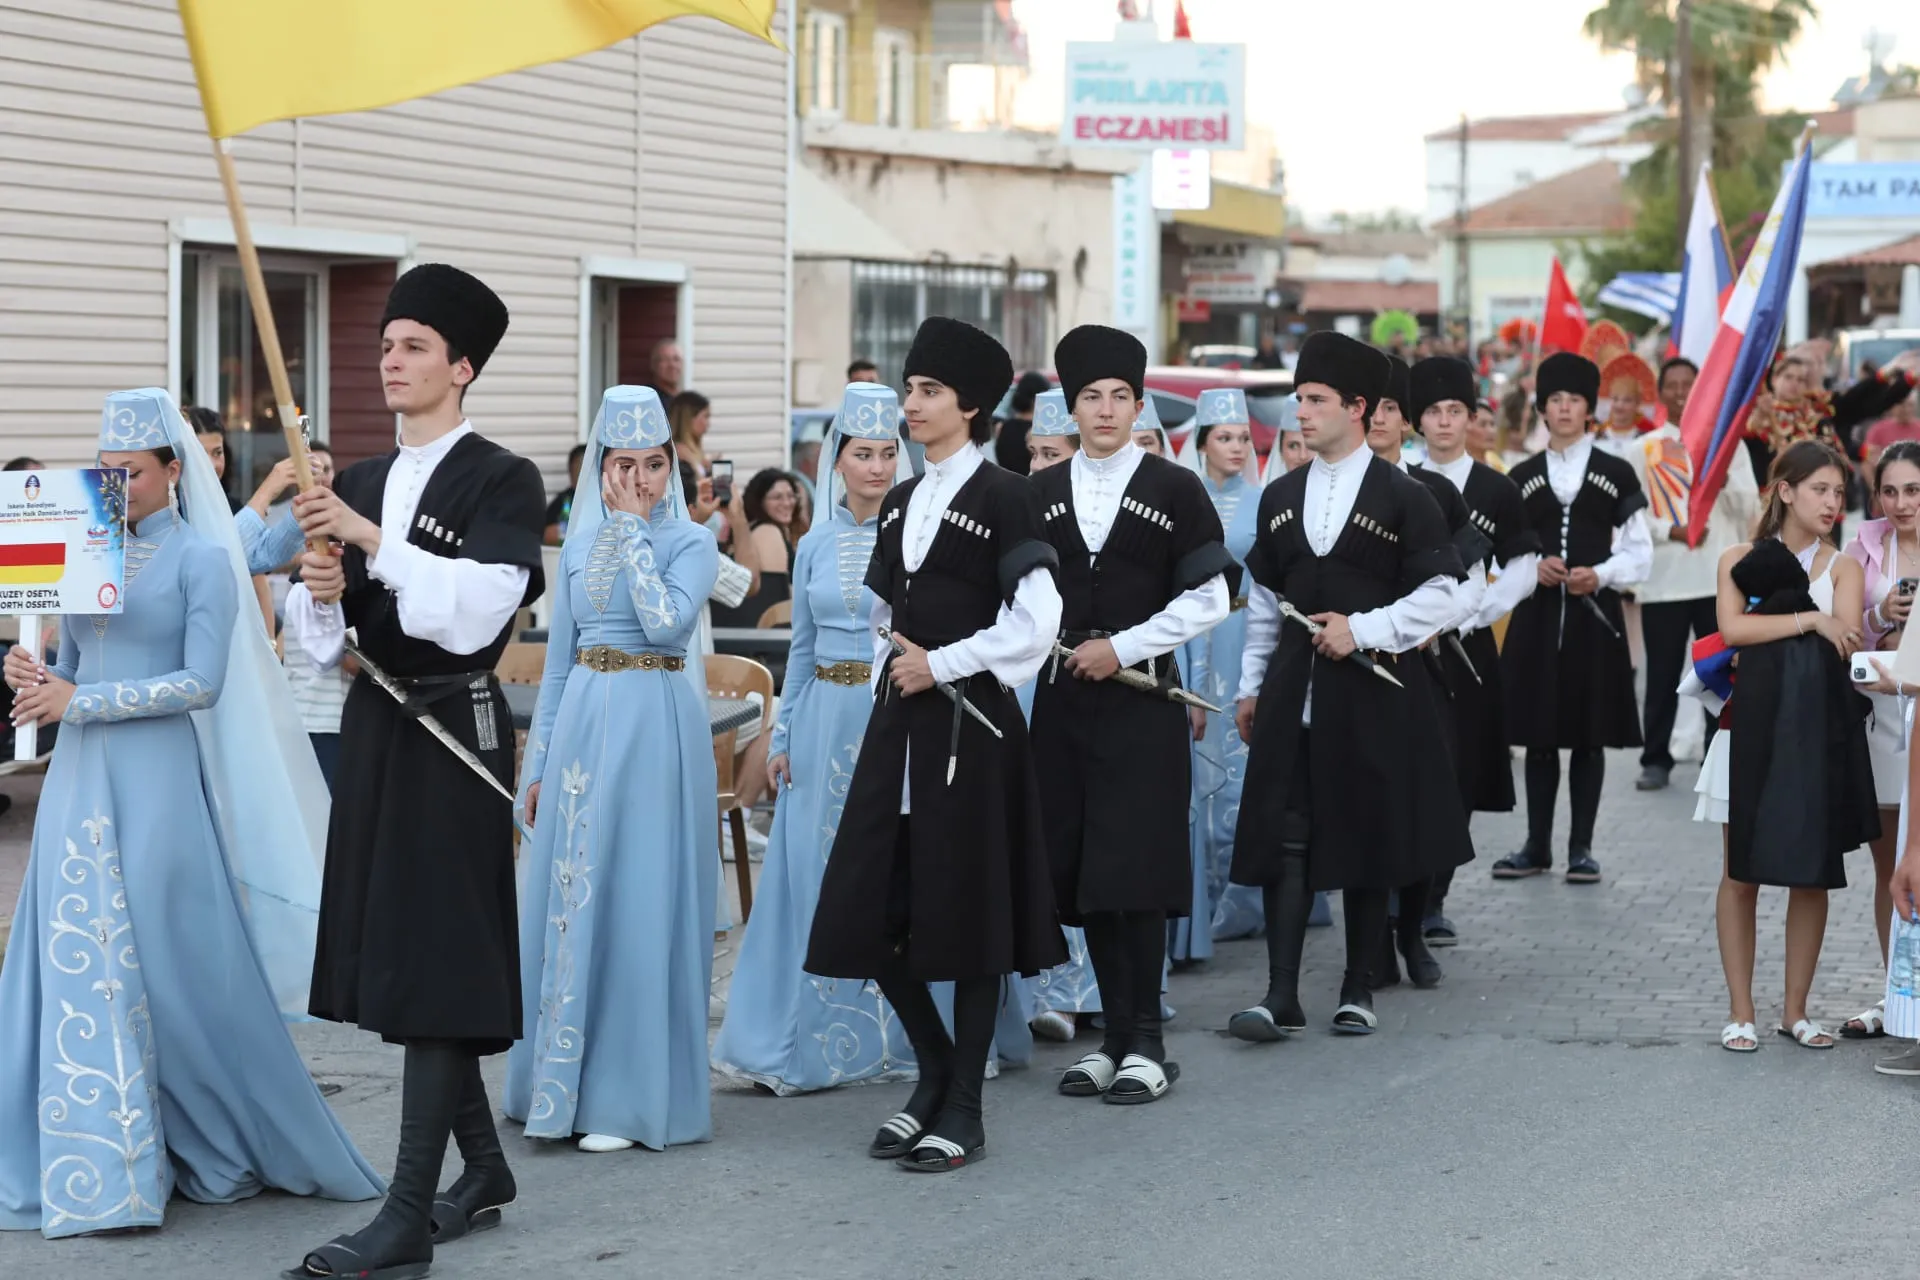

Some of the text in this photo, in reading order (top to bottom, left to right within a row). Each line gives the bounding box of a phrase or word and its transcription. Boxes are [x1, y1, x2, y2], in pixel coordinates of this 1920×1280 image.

[1075, 112, 1229, 142] ECZANESİ
[1822, 177, 1920, 198] TAM PA
[27, 589, 59, 598] OSETYA
[0, 600, 60, 609] ORTH OSSETIA
